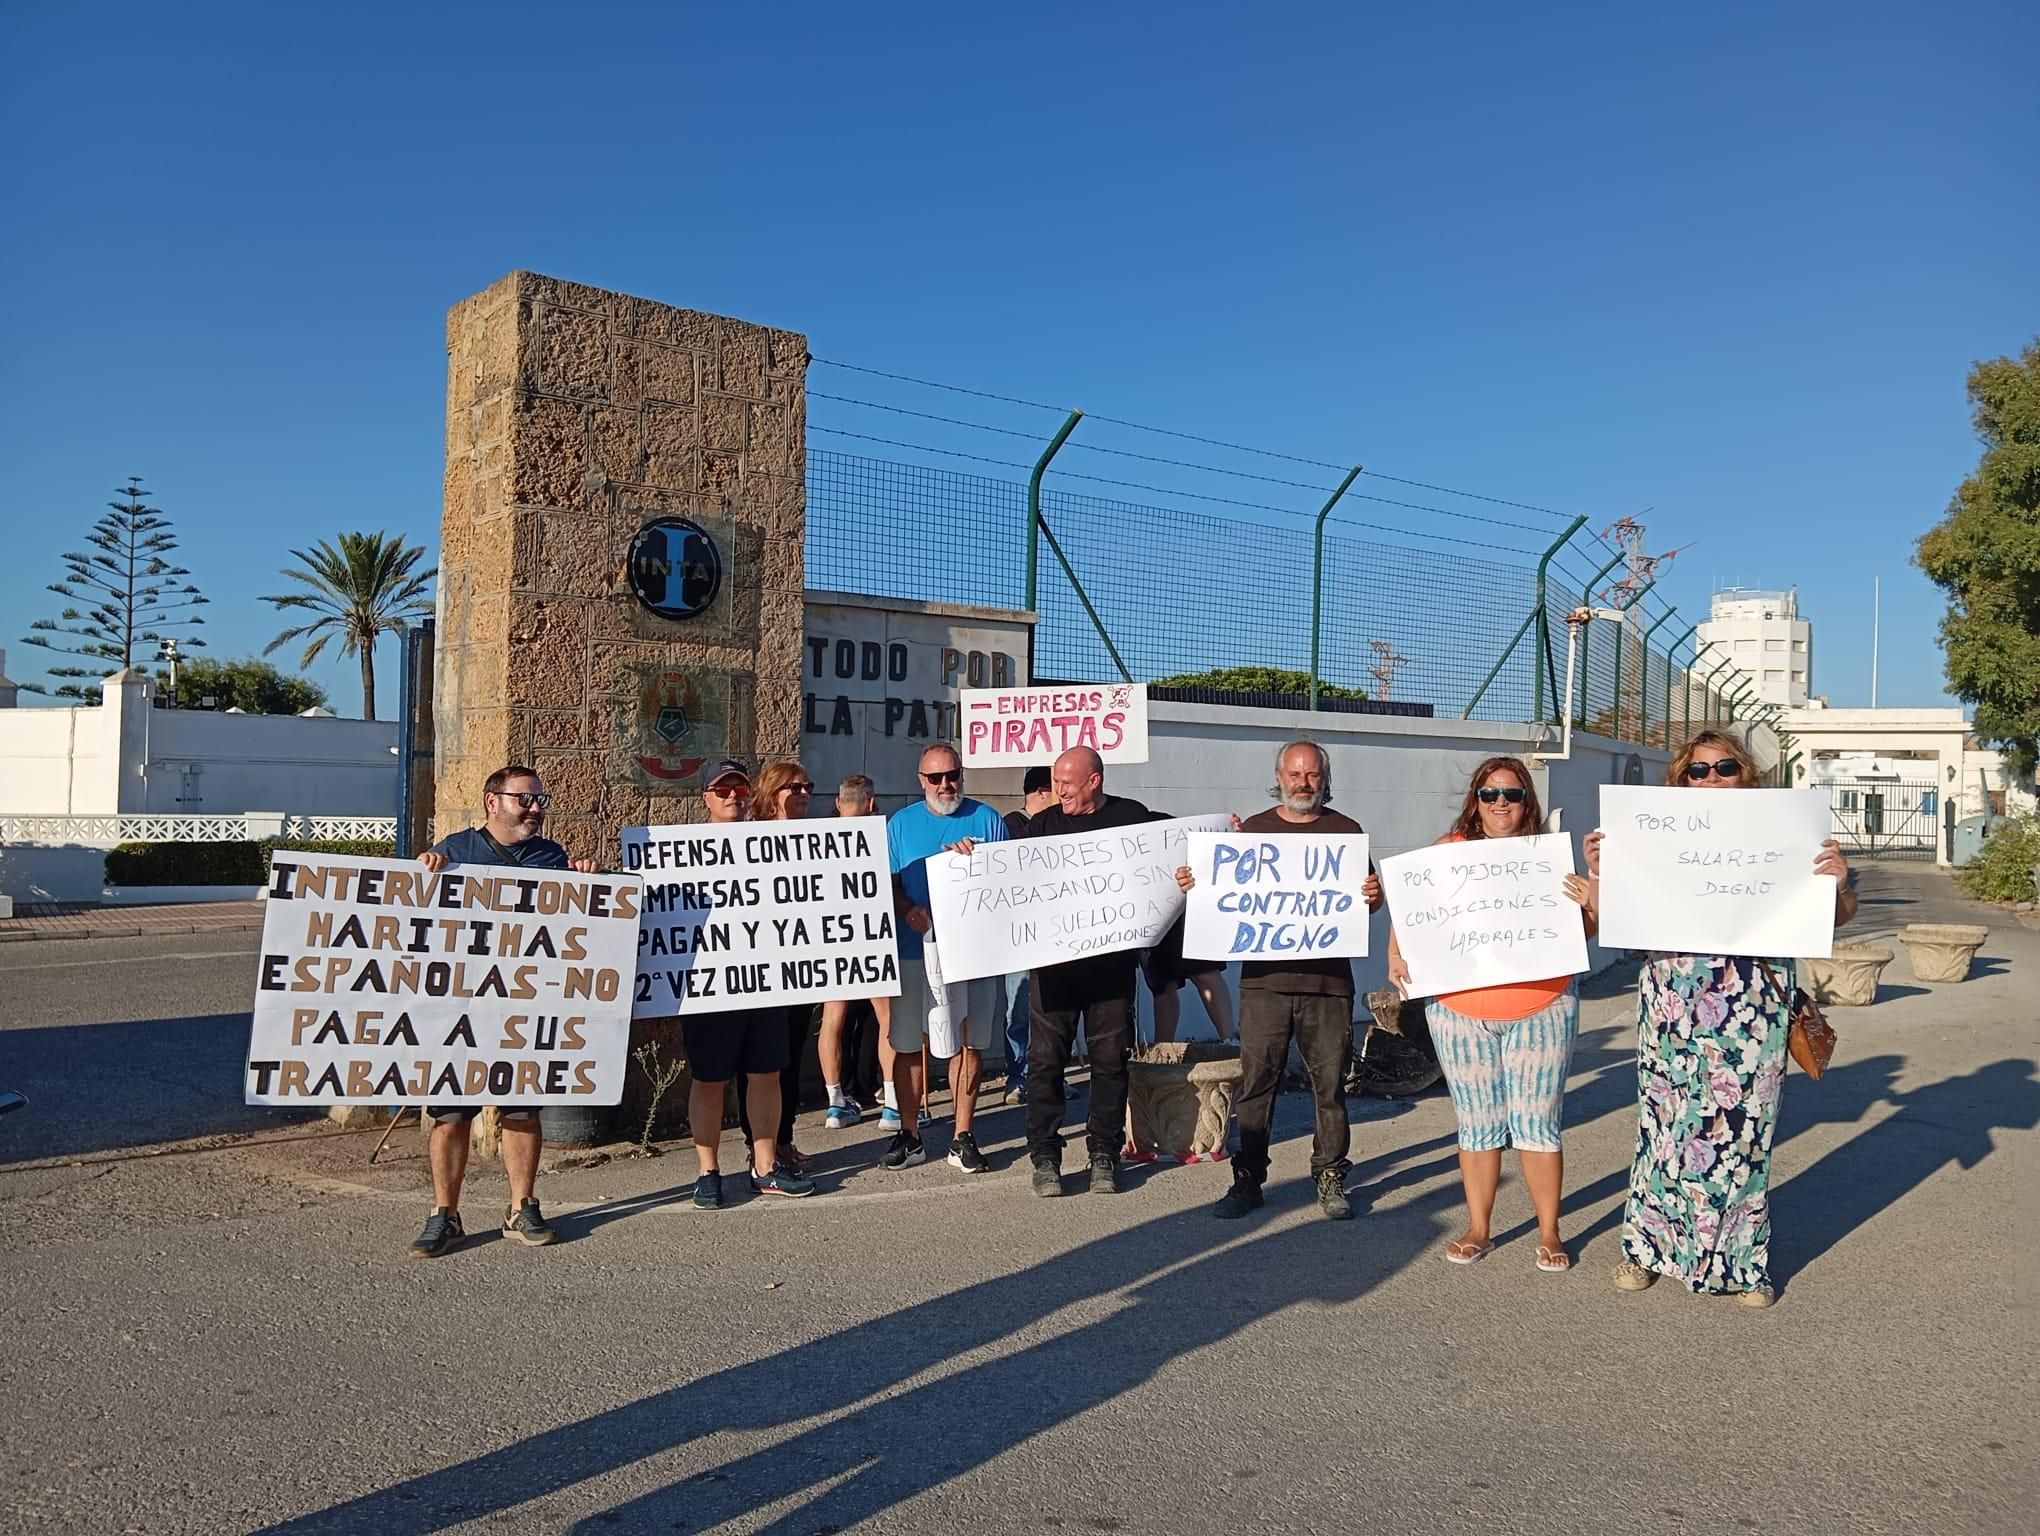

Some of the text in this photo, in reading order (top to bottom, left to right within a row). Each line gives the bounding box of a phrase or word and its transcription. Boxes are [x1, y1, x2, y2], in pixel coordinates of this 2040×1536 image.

[640, 556, 709, 581] INTA
[807, 637, 1008, 689] TODO POR
[805, 692, 854, 736] LA
[998, 692, 1102, 714] EMPRESAS
[969, 712, 1126, 755] PIRATAS
[1635, 809, 1712, 832] POR UN
[628, 830, 871, 870] DEFENSA CONTRATA
[948, 849, 1007, 882] SEIS
[1018, 838, 1113, 873] PADRES
[1120, 832, 1152, 859] DE
[1211, 843, 1347, 885] POR UN
[1677, 849, 1784, 867] SALARIO
[269, 862, 639, 919] INTERVENCIONES
[641, 871, 878, 913] MPRESAS QUE NO
[960, 864, 1174, 917] TRABAJANDO SIN
[1403, 861, 1552, 900] POR MEJORES
[1695, 881, 1776, 897] DIGNO
[1216, 889, 1353, 917] CONTRATO
[1405, 891, 1558, 928] CONDICIONES
[306, 911, 588, 961] MARITIMAS
[638, 912, 893, 957] PAGAN Y YA ES LA
[1011, 919, 1037, 947] UN
[1049, 902, 1136, 938] SUELDO
[1228, 921, 1339, 954] DIGNO
[1450, 927, 1558, 956] LABORALES
[666, 967, 717, 999] VEZ
[725, 963, 772, 994] QUE
[781, 958, 828, 990] NOS
[835, 954, 897, 985] PASA
[291, 1008, 586, 1051] PAGA A SUS
[250, 1060, 597, 1097] TRABAJADORES
